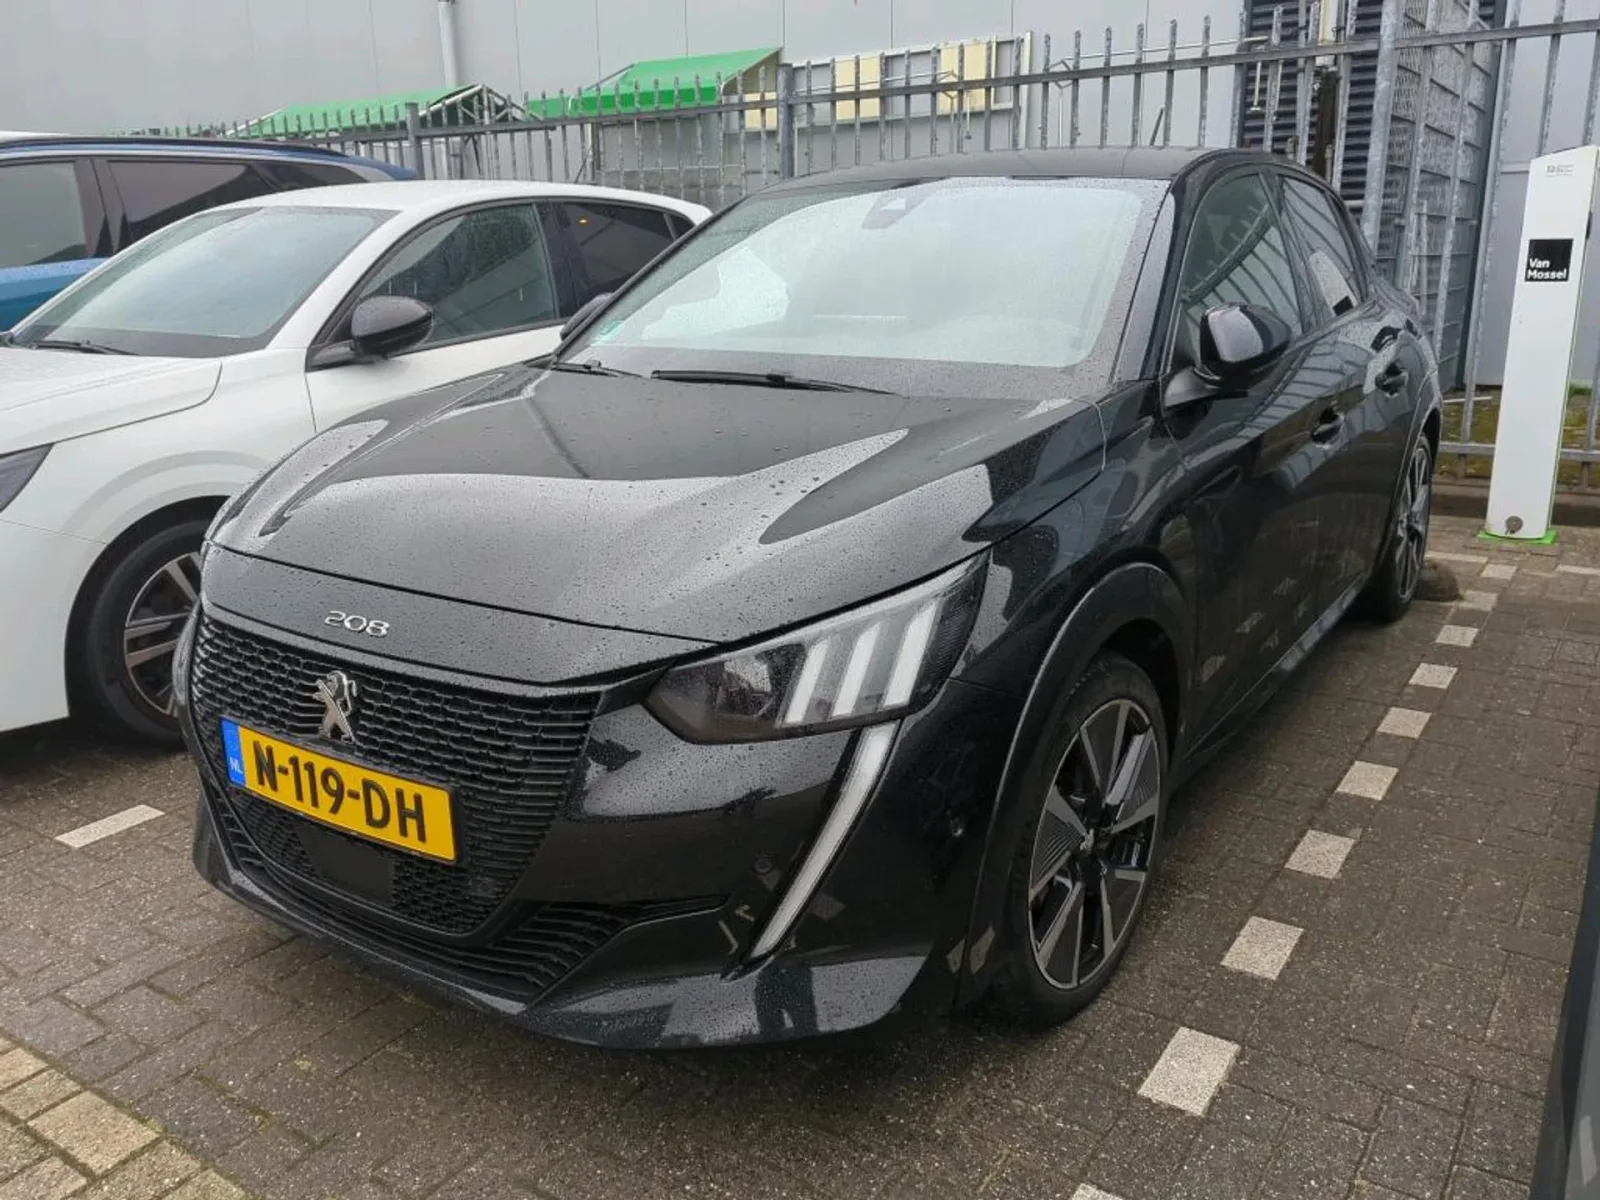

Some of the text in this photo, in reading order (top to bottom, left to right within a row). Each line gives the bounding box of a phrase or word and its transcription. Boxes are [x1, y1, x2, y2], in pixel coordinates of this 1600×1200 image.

[1529, 258, 1550, 268] Van
[1527, 268, 1567, 279] Mossel
[324, 610, 390, 636] 208
[229, 756, 244, 774] NL
[252, 739, 426, 844] N-119-DH
